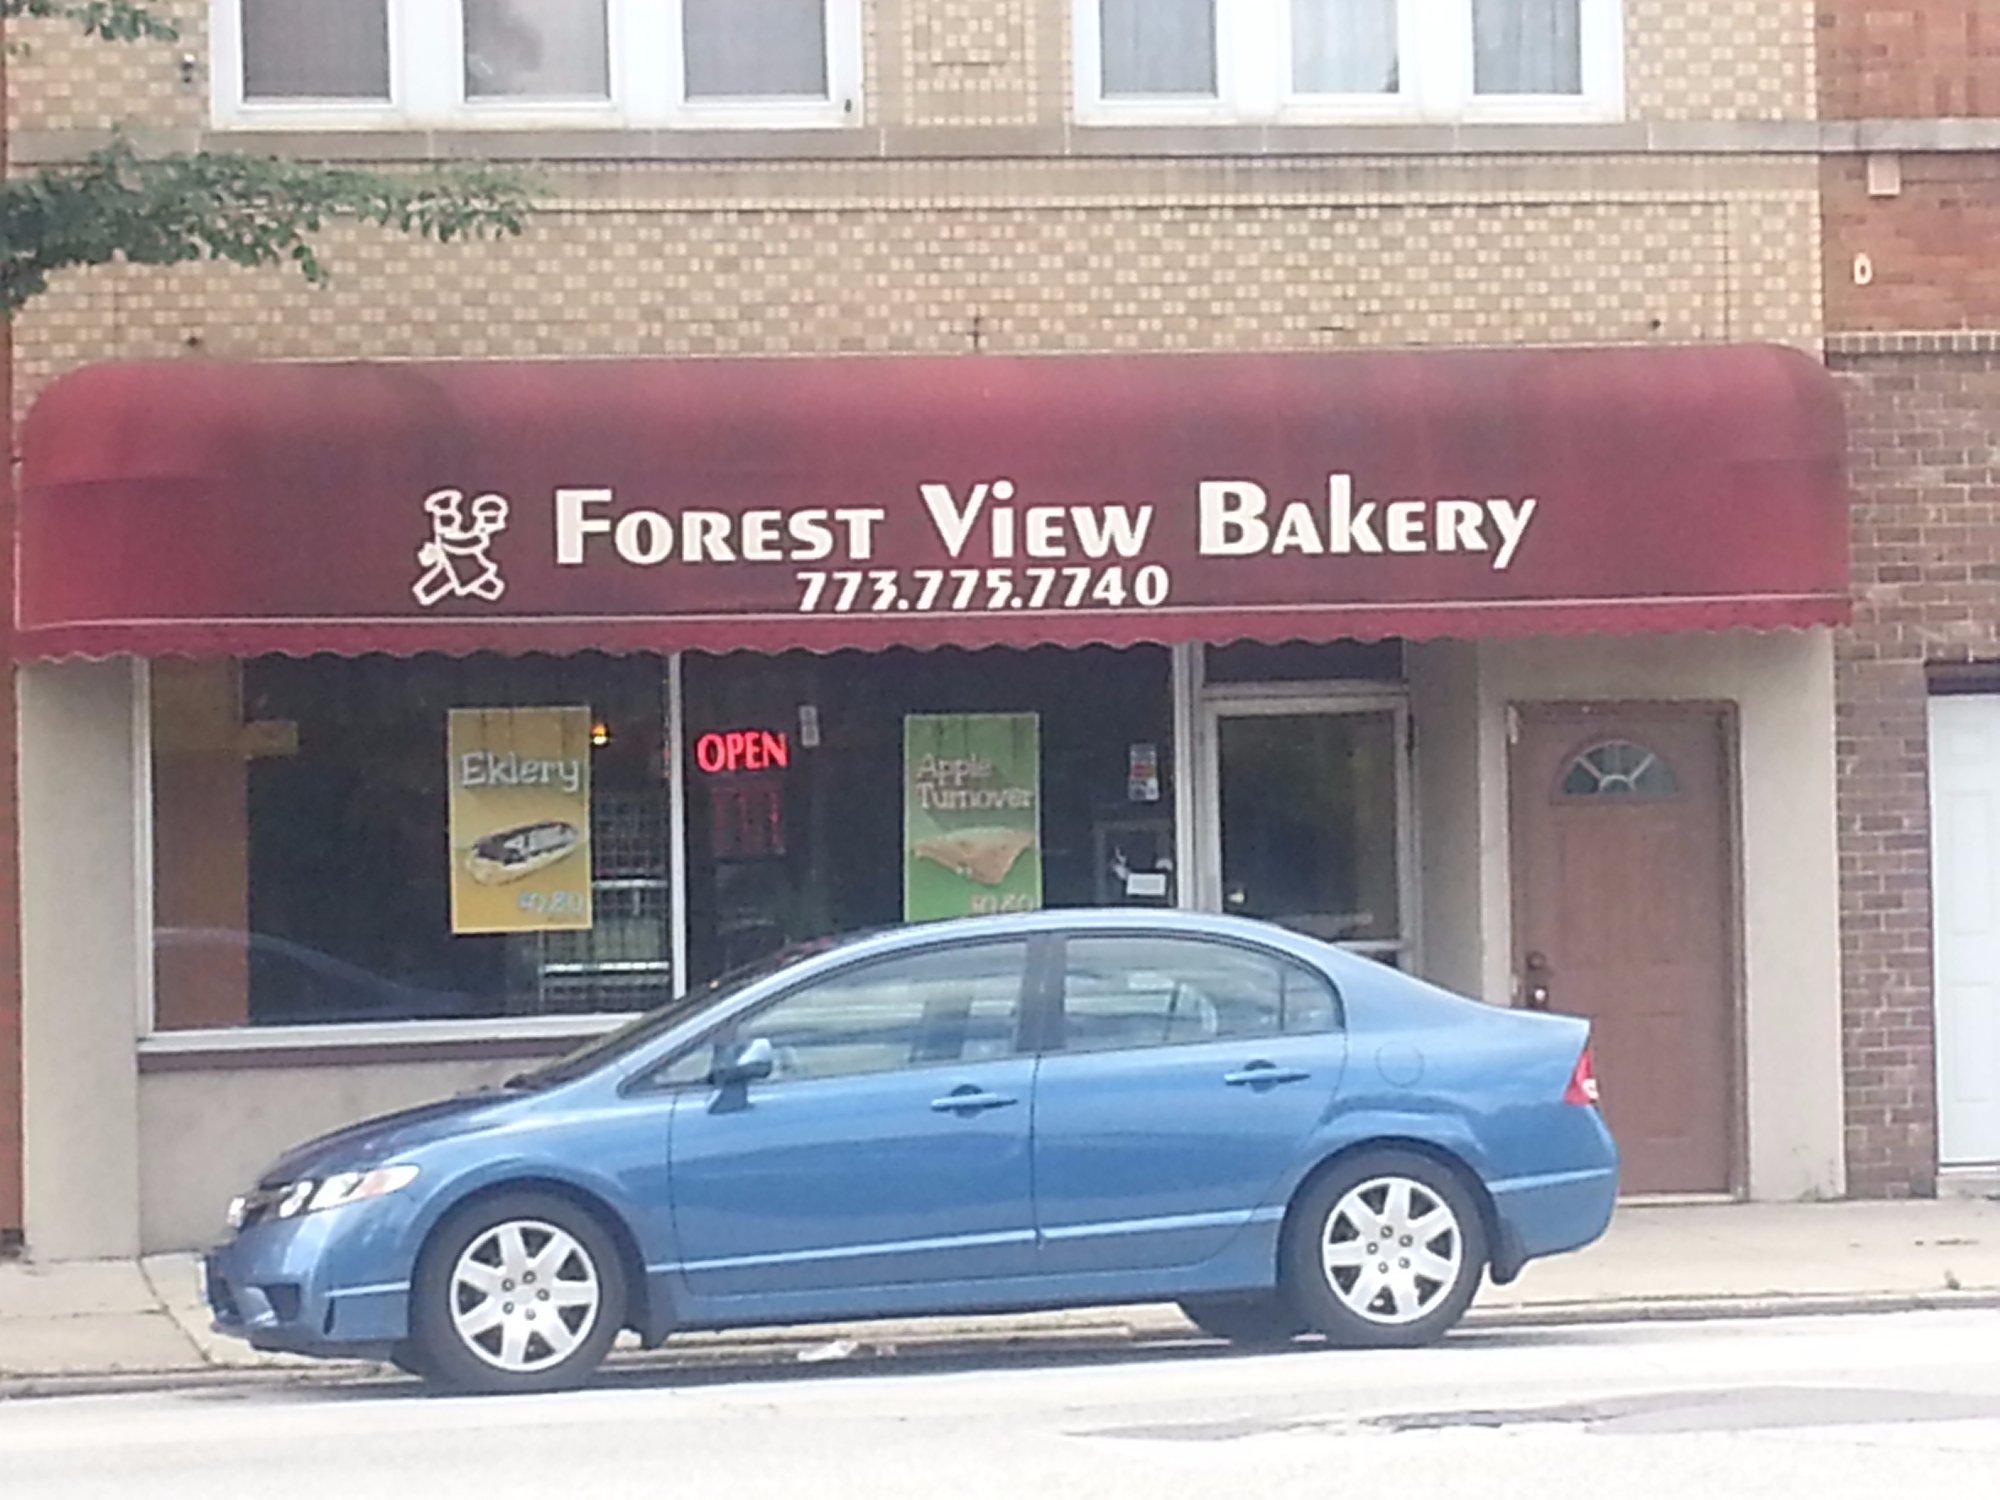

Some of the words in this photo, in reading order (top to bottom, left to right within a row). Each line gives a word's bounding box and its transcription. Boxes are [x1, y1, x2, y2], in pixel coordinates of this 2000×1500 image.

[796, 564, 1170, 612] 773.775.7740
[461, 751, 581, 792] Eklery
[696, 731, 788, 773] OPEN
[916, 752, 993, 786] Apple
[916, 781, 1034, 809] Turnover
